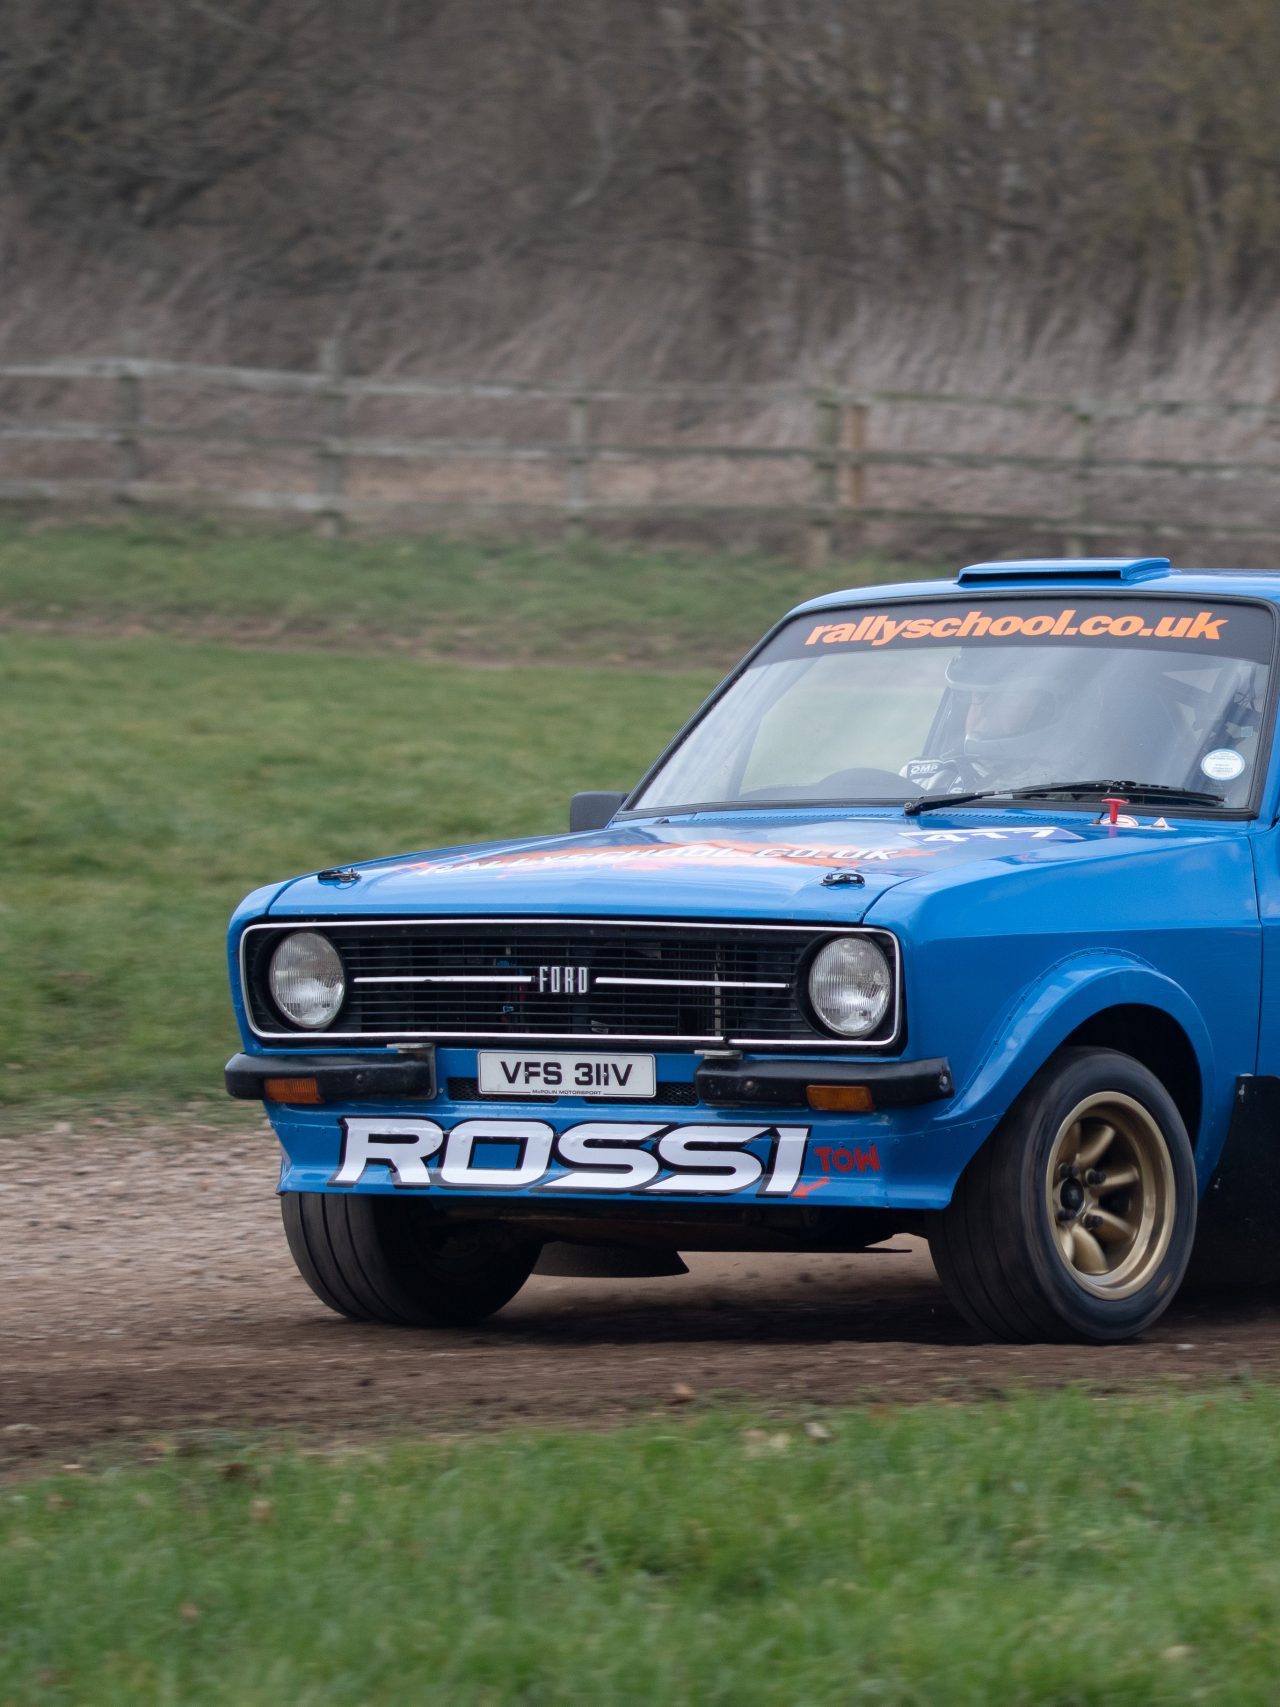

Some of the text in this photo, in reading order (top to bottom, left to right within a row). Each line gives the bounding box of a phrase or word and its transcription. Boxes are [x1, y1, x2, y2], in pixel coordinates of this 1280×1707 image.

[804, 609, 1230, 647] rallyschool.co.uk
[539, 965, 589, 994] FORD
[500, 1061, 633, 1087] VFS 311V
[333, 1116, 812, 1198] ROSSI
[815, 1144, 881, 1173] TOW
